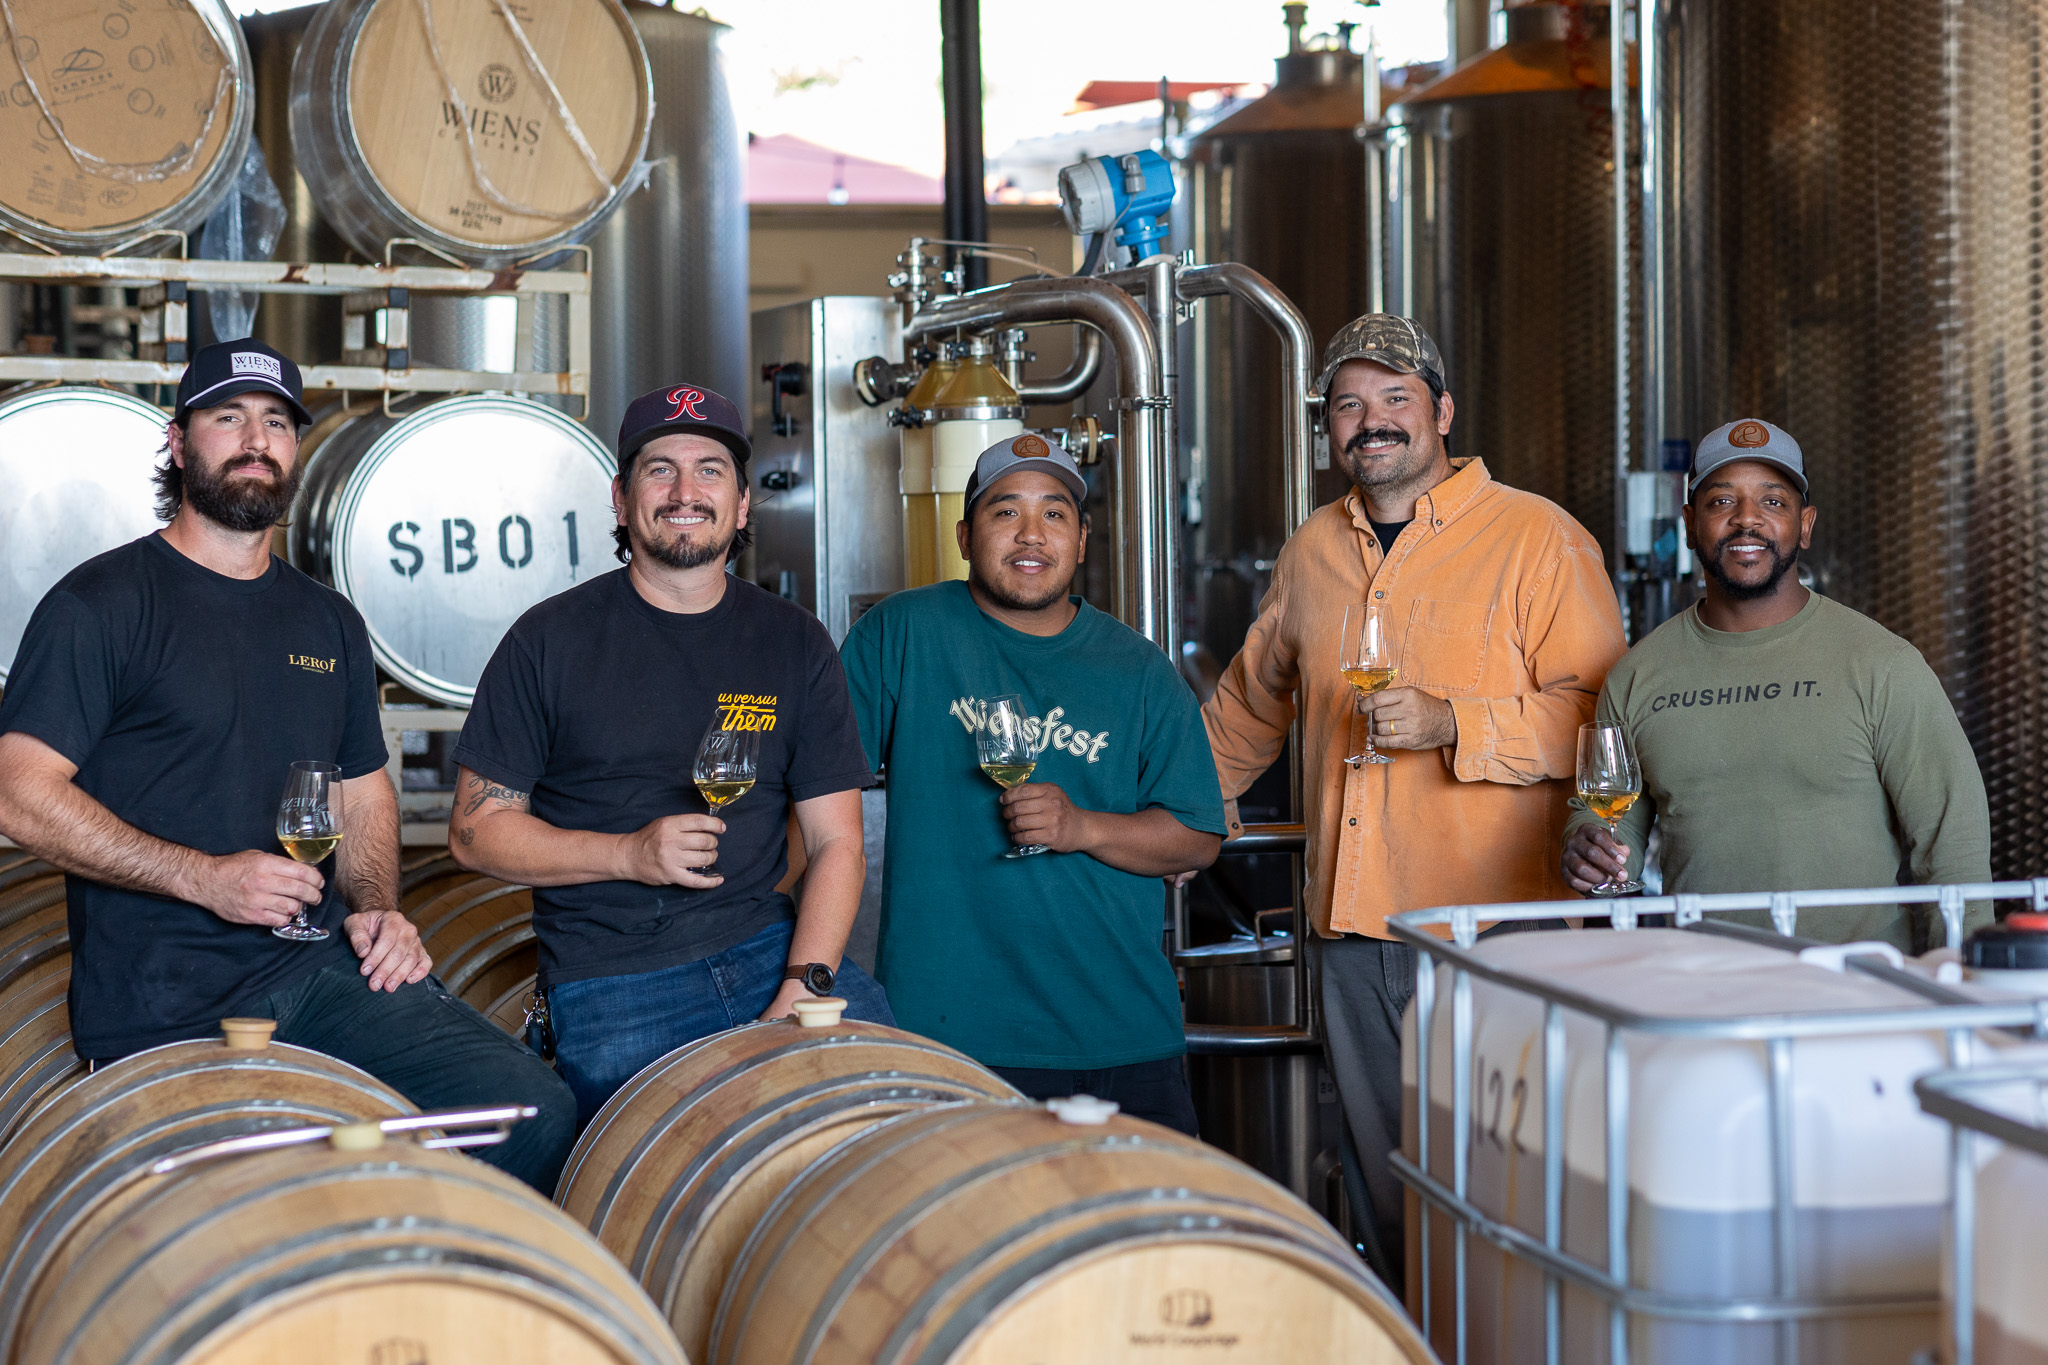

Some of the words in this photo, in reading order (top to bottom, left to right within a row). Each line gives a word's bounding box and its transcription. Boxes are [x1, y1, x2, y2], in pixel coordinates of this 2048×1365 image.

[489, 75, 509, 94] W
[442, 101, 541, 145] WIENS
[438, 129, 534, 156] CELARS
[234, 356, 279, 371] WIENS
[664, 387, 707, 420] R
[288, 654, 336, 672] LEROI
[718, 693, 732, 703] us
[734, 694, 777, 705] versus
[1652, 682, 1781, 712] CRUSHING
[1792, 681, 1822, 698] IT.
[949, 696, 1109, 763] Wiensfest
[1475, 1055, 1528, 1154] 122
